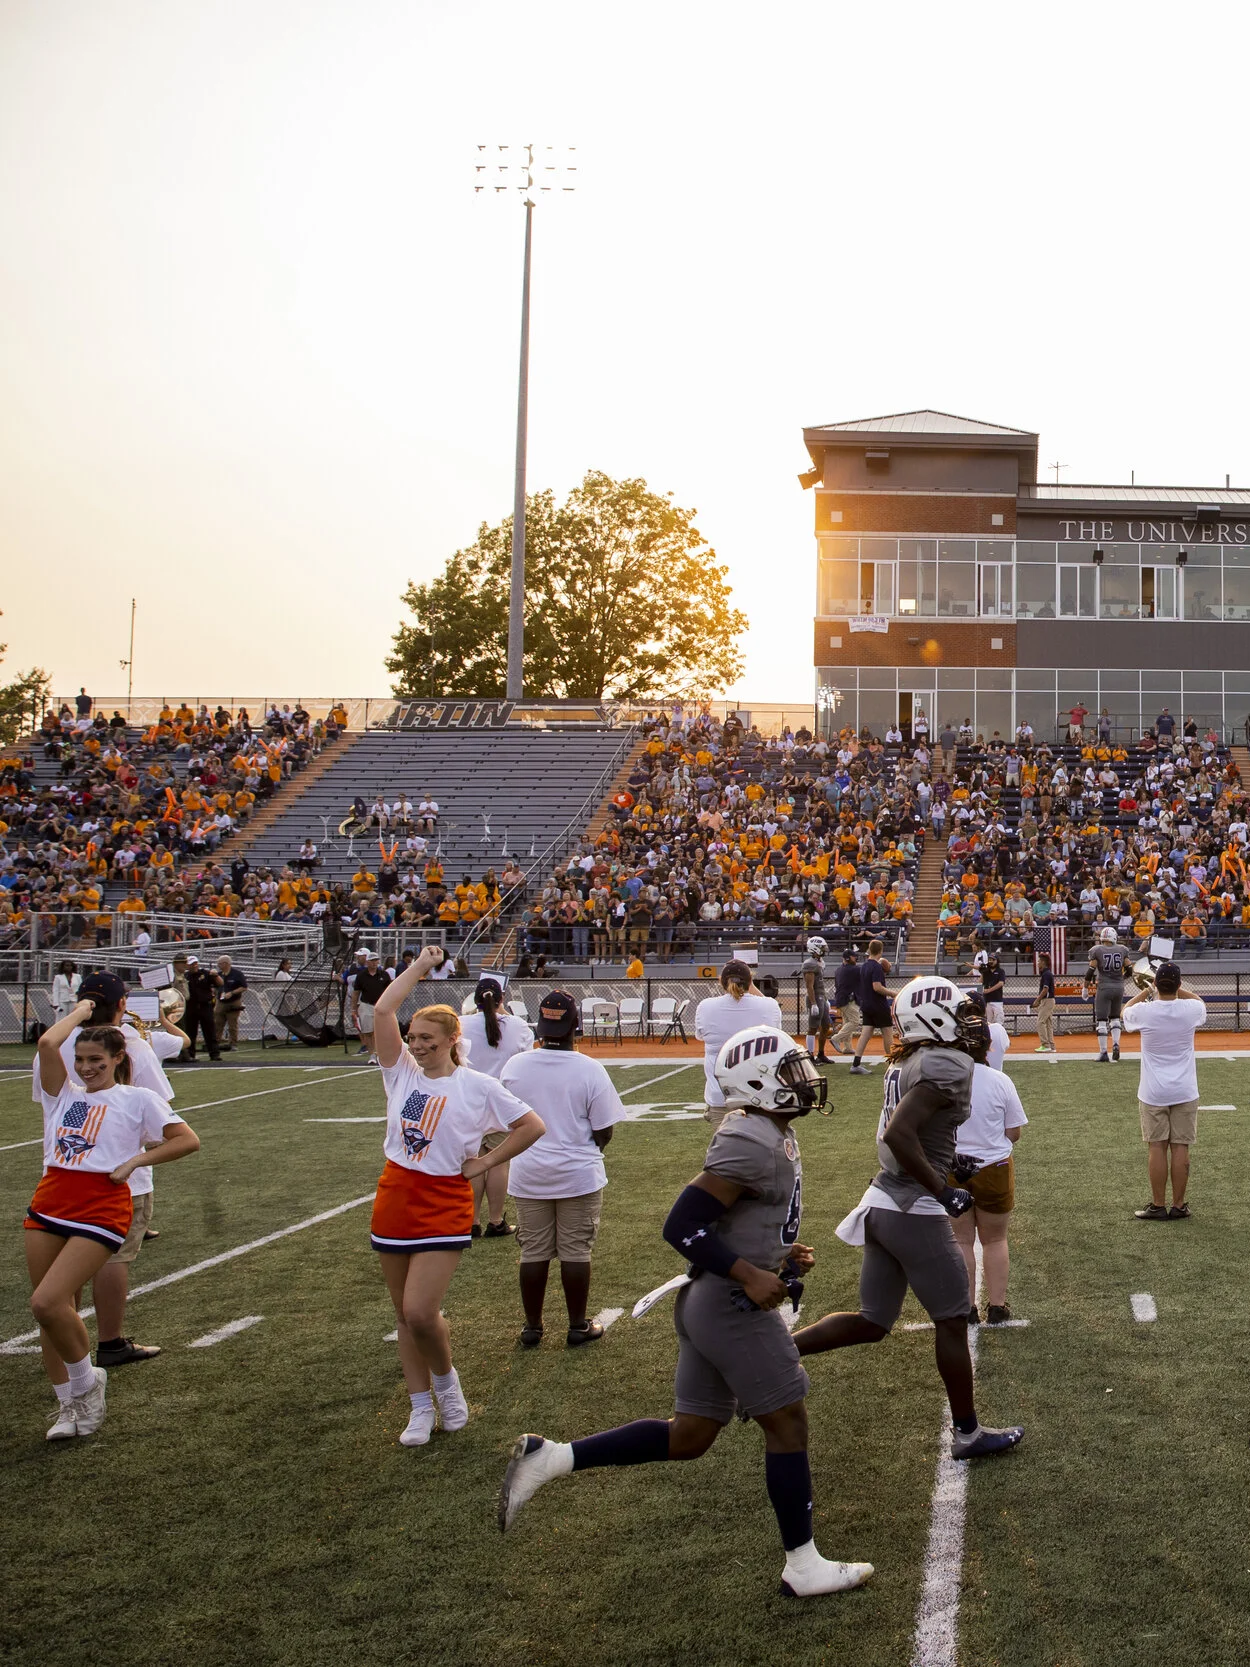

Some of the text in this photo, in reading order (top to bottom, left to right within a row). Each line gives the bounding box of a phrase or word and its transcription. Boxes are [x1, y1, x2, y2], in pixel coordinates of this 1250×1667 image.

[1059, 521, 1115, 541] THE
[702, 967, 712, 978] C
[1103, 953, 1123, 972] 76
[910, 986, 953, 1009] UTM
[724, 1035, 779, 1070] UTM
